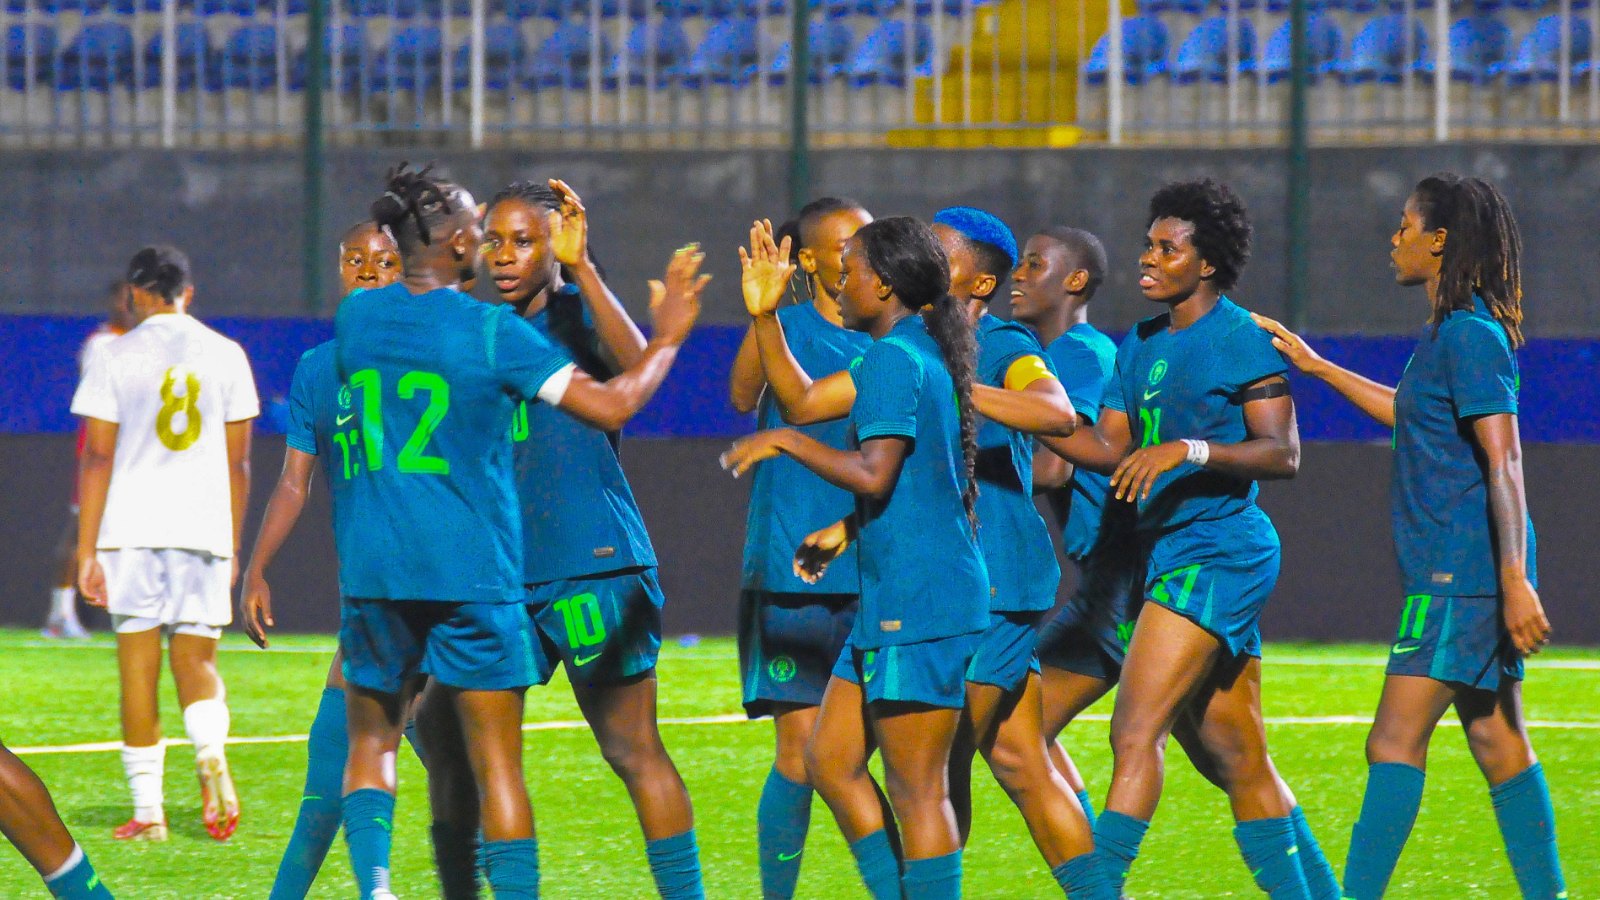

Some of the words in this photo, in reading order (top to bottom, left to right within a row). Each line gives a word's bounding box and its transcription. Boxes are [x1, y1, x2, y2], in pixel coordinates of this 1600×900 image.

[156, 364, 203, 452] 8
[350, 368, 450, 475] 12
[553, 592, 606, 649] 10
